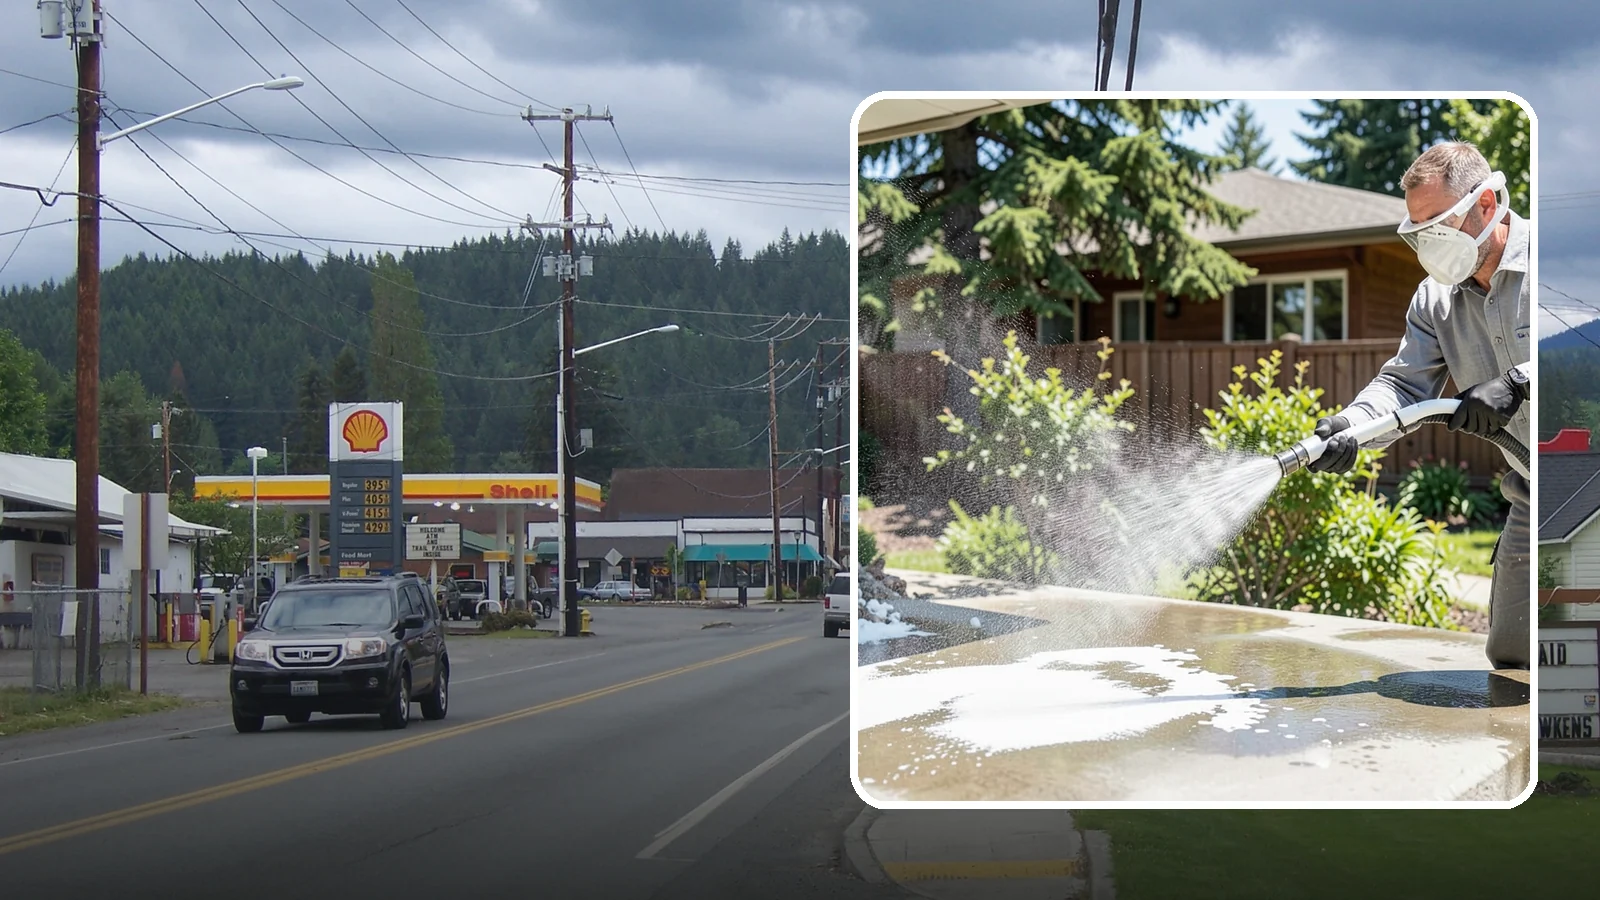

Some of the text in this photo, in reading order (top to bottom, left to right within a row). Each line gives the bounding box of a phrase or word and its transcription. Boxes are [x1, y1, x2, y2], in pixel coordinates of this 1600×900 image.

[366, 480, 383, 490] 395
[490, 484, 547, 499] Shell
[365, 494, 383, 504] 405
[366, 508, 383, 518] 415
[366, 522, 383, 532] 429
[1538, 643, 1567, 665] AID
[1538, 716, 1592, 738] WKENS
